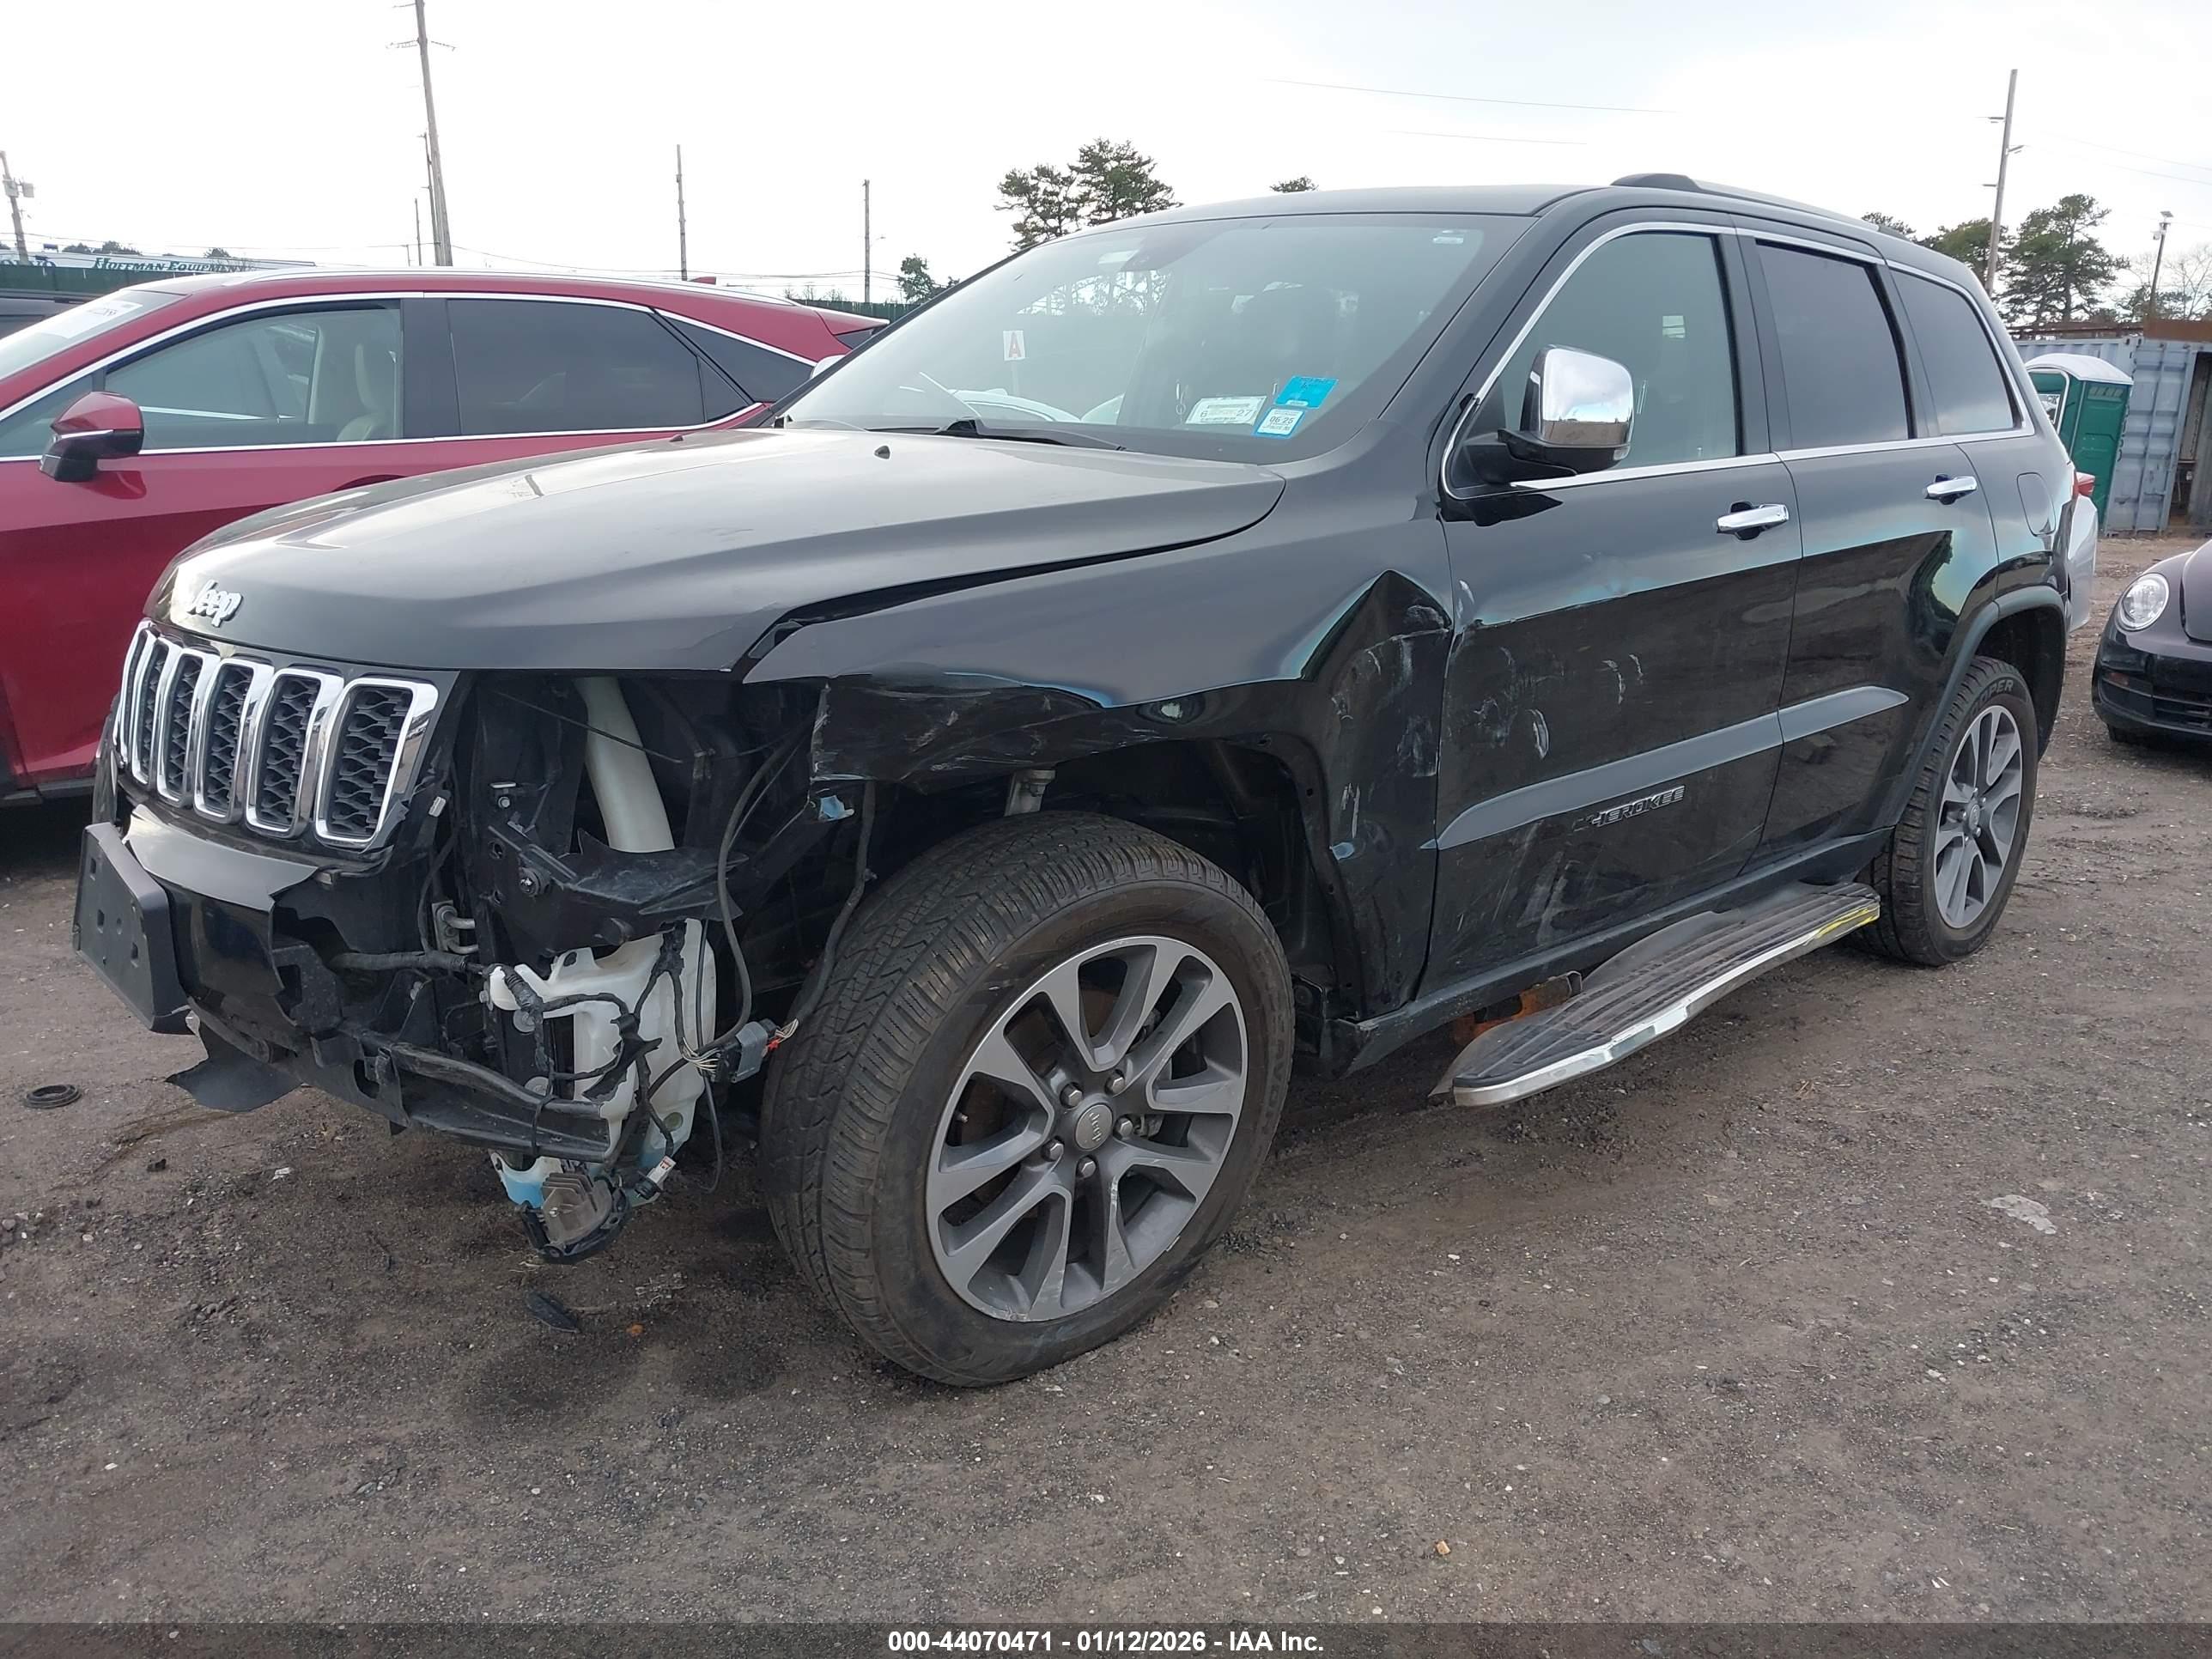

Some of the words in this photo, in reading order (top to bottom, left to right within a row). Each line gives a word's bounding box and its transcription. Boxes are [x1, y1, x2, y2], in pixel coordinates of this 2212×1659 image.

[93, 257, 166, 272] HOFFMAN
[1008, 331, 1022, 358] A
[186, 579, 244, 628] Jeep
[1571, 784, 1685, 832] CHEROKEE
[1089, 1112, 1103, 1142] Jeep
